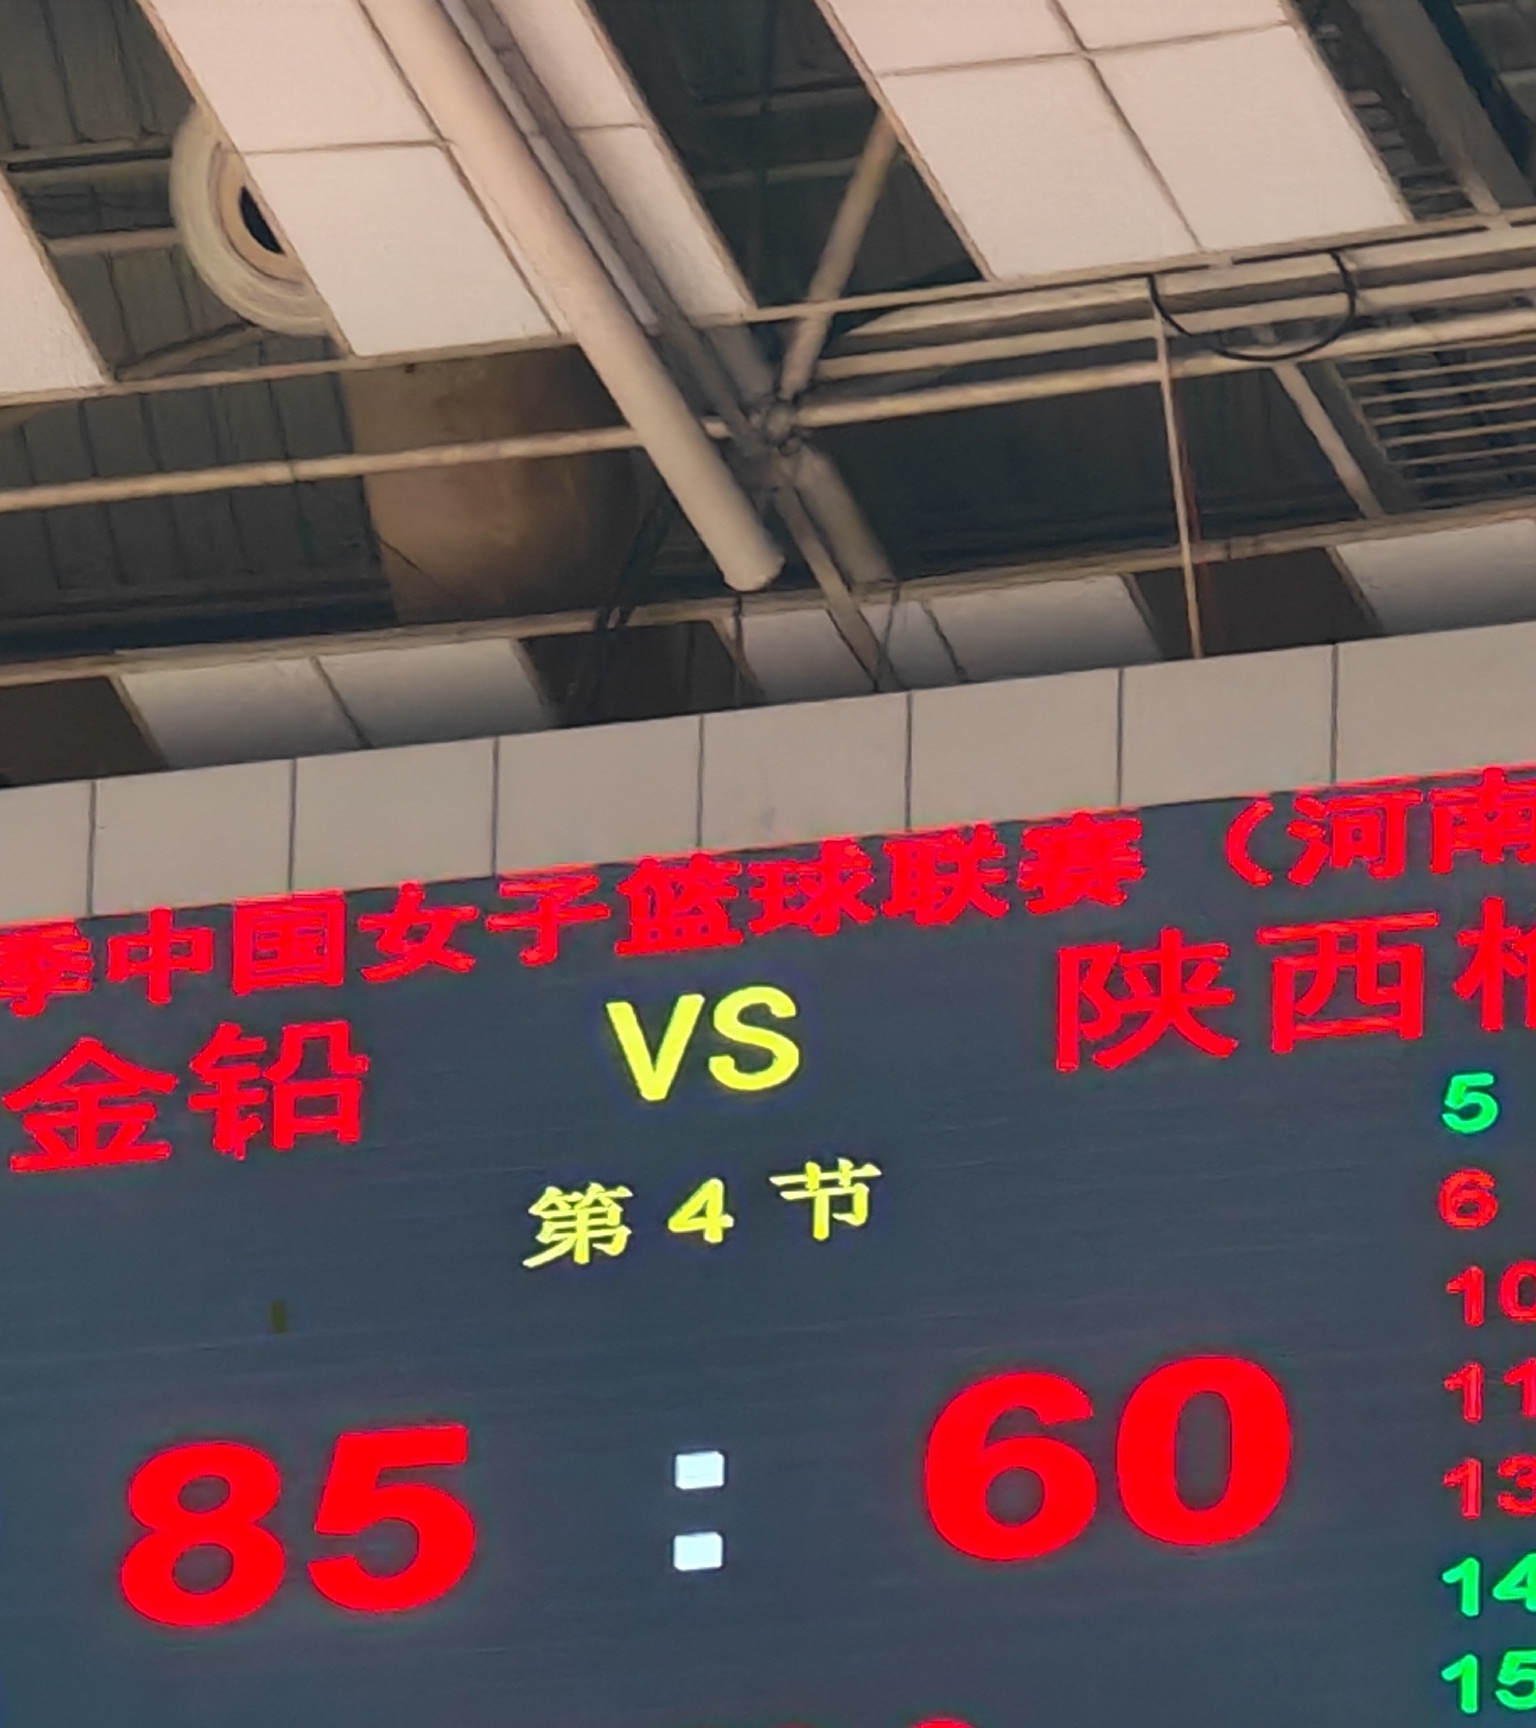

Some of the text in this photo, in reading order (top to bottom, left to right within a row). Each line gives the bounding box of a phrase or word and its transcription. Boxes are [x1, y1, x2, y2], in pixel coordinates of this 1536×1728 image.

[606, 985, 803, 1102] VS
[1441, 1071, 1499, 1135] 5
[1437, 1168, 1499, 1231] 6
[119, 1422, 477, 1629] 85
[923, 1353, 1293, 1563] 60
